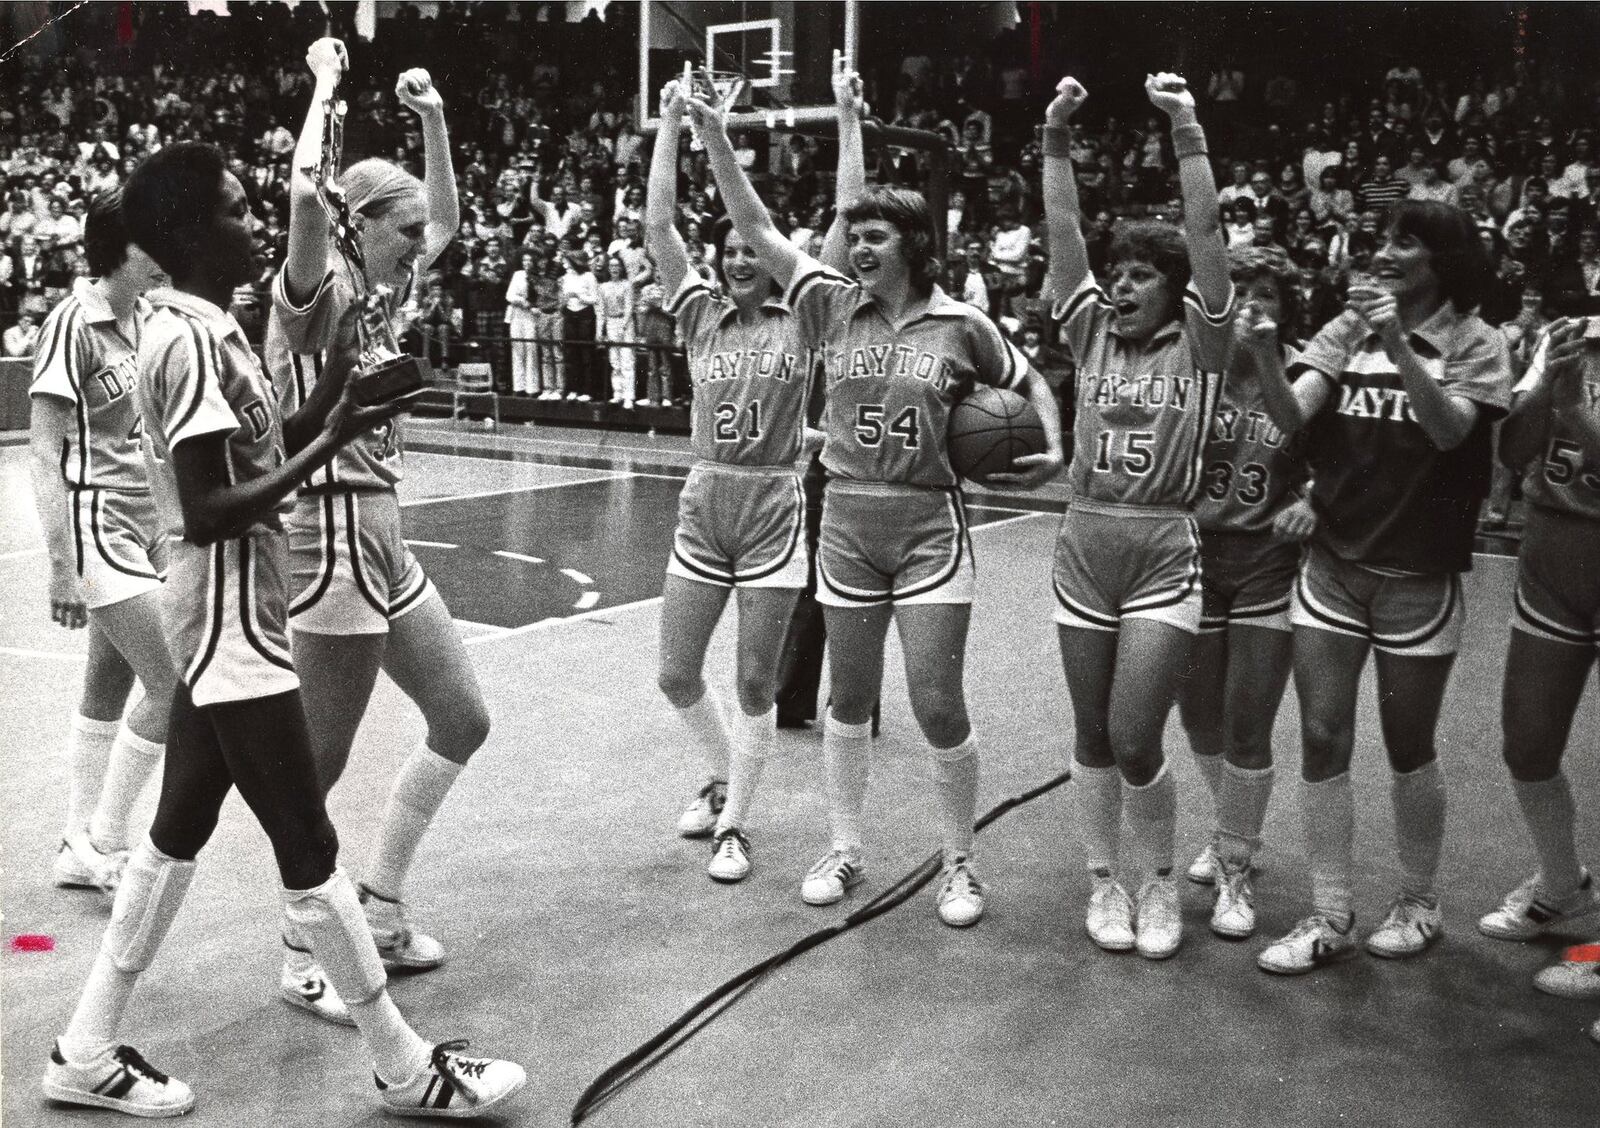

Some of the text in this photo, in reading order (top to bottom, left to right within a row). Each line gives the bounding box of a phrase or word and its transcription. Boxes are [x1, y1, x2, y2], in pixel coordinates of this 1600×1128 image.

[698, 348, 797, 383] AYTON
[1085, 372, 1194, 411] AYTON
[714, 400, 761, 442] 21
[855, 403, 920, 449] 54
[1093, 430, 1156, 476] 15
[1204, 461, 1270, 506] 33
